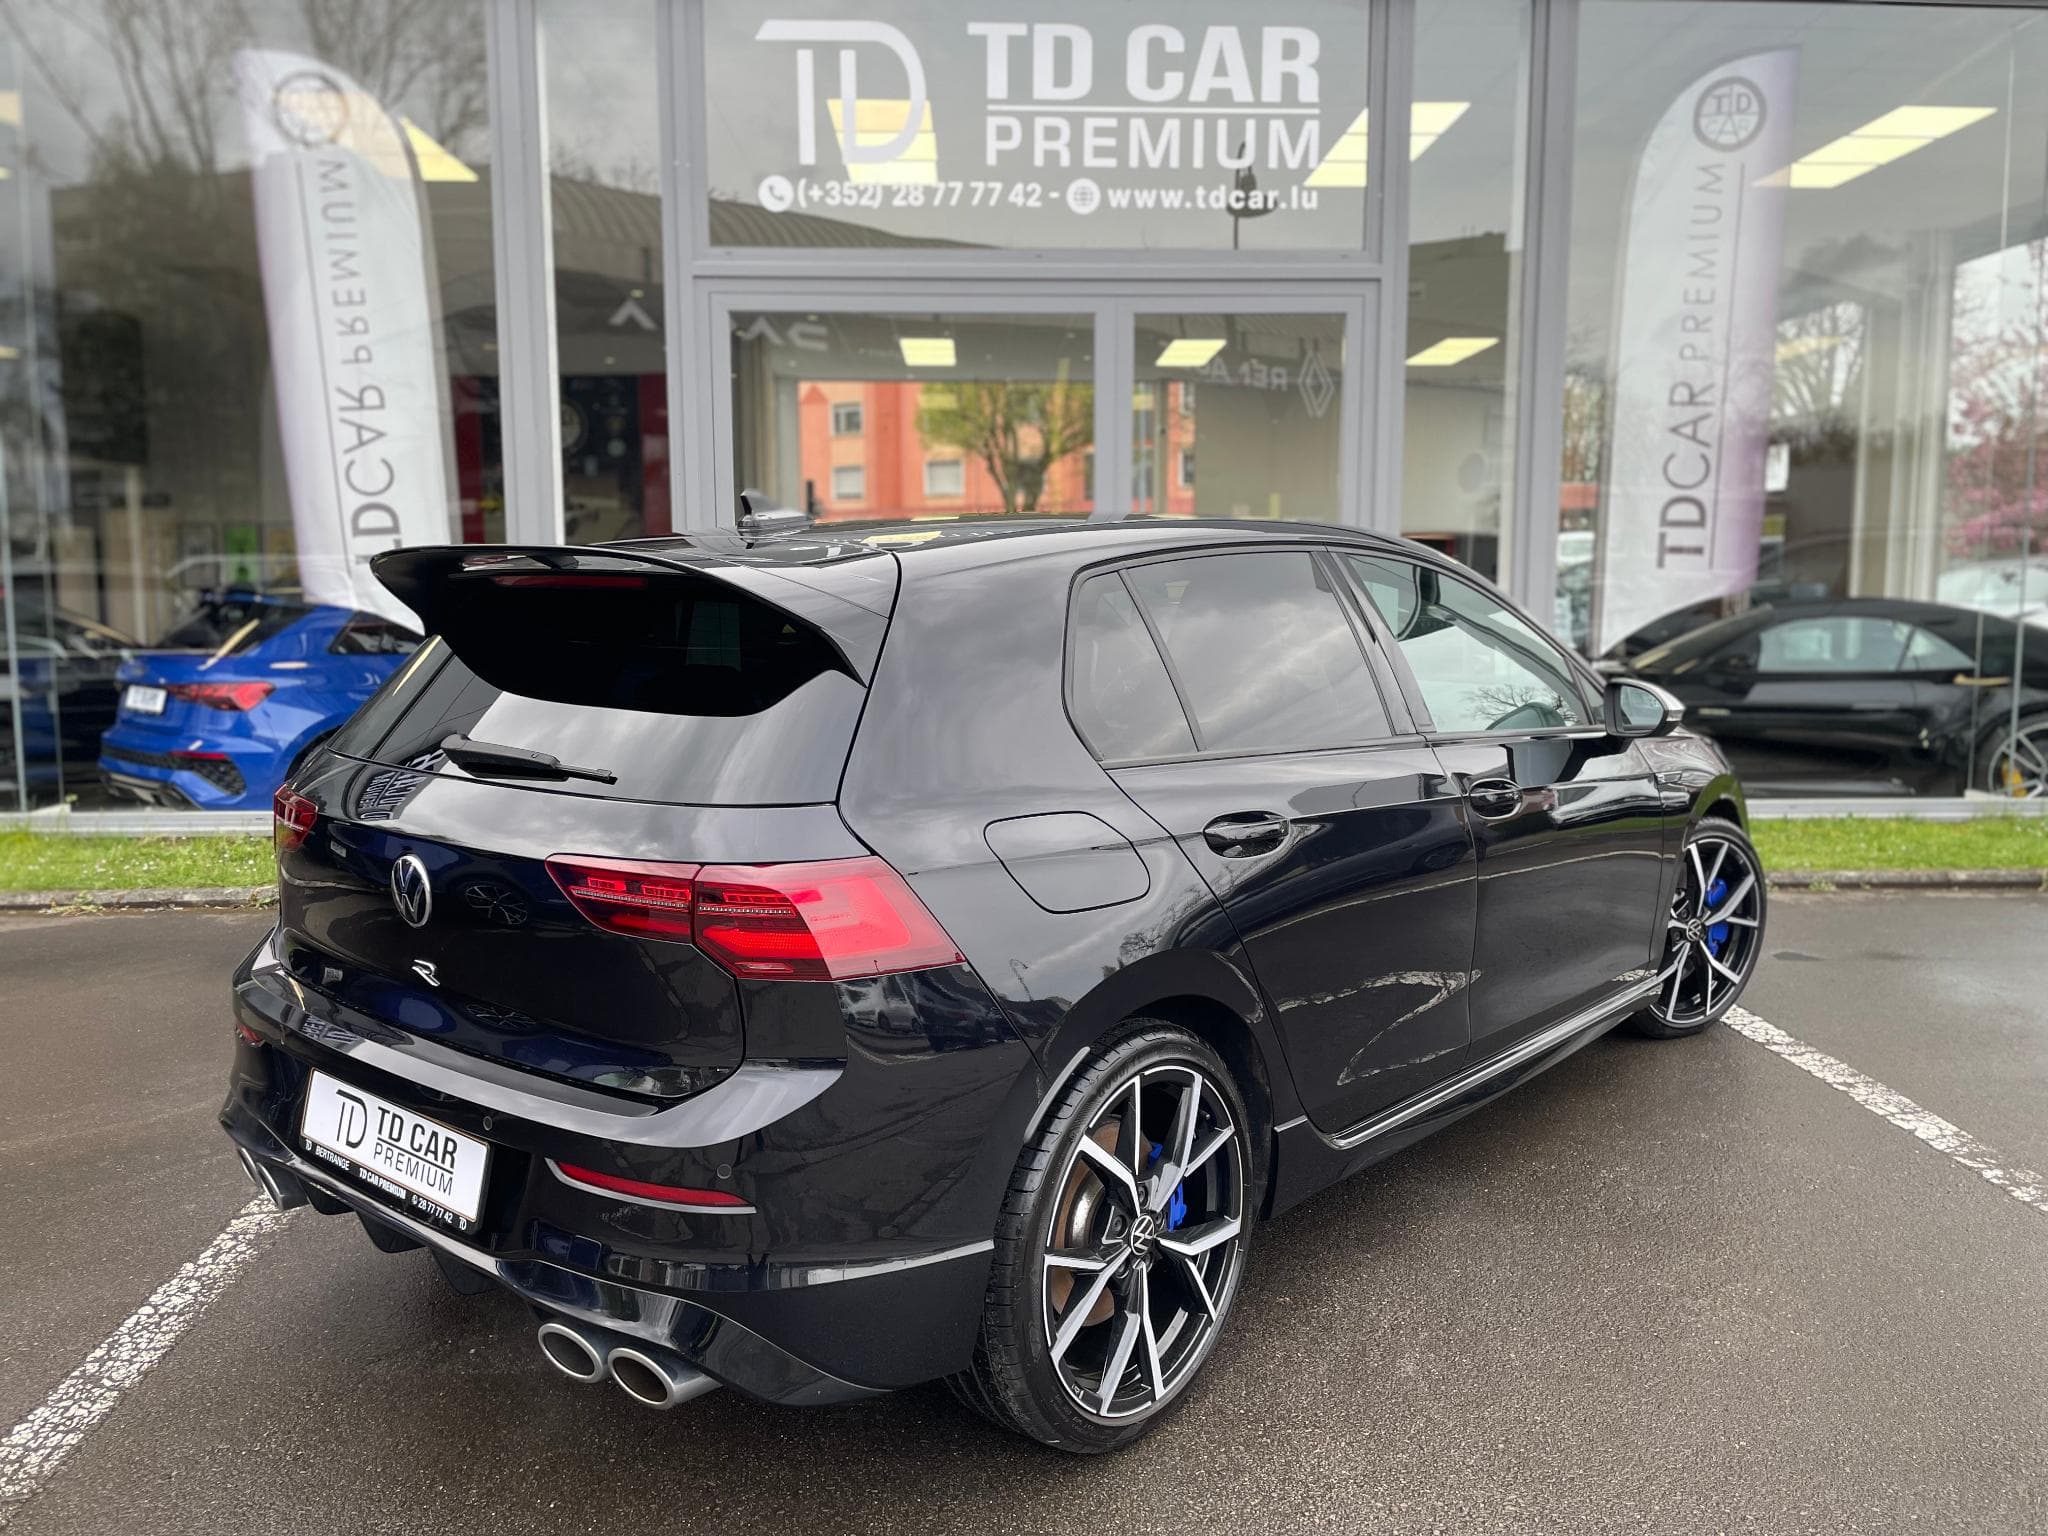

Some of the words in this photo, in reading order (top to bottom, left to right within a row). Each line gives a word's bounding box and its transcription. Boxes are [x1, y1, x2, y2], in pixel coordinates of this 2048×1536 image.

[967, 22, 1093, 100] TD
[1126, 24, 1320, 102] CAR
[986, 116, 1320, 169] PREMIUM
[797, 178, 883, 209] (+352)
[892, 181, 926, 207] 28
[933, 181, 964, 207] 77
[969, 181, 1003, 207] 77
[1007, 182, 1043, 207] 42
[1107, 184, 1319, 210] www.tdcar.lu
[1678, 162, 1726, 363] PREMIUM
[1656, 380, 1716, 570] TDCAR
[315, 1145, 351, 1171] BERTRANGE
[378, 1106, 405, 1143] TD
[410, 1123, 457, 1169] CAR
[359, 1167, 368, 1180] TD
[367, 1171, 379, 1187] CAR
[378, 1178, 407, 1200] PREMIUM
[373, 1142, 453, 1196] PREMIUM
